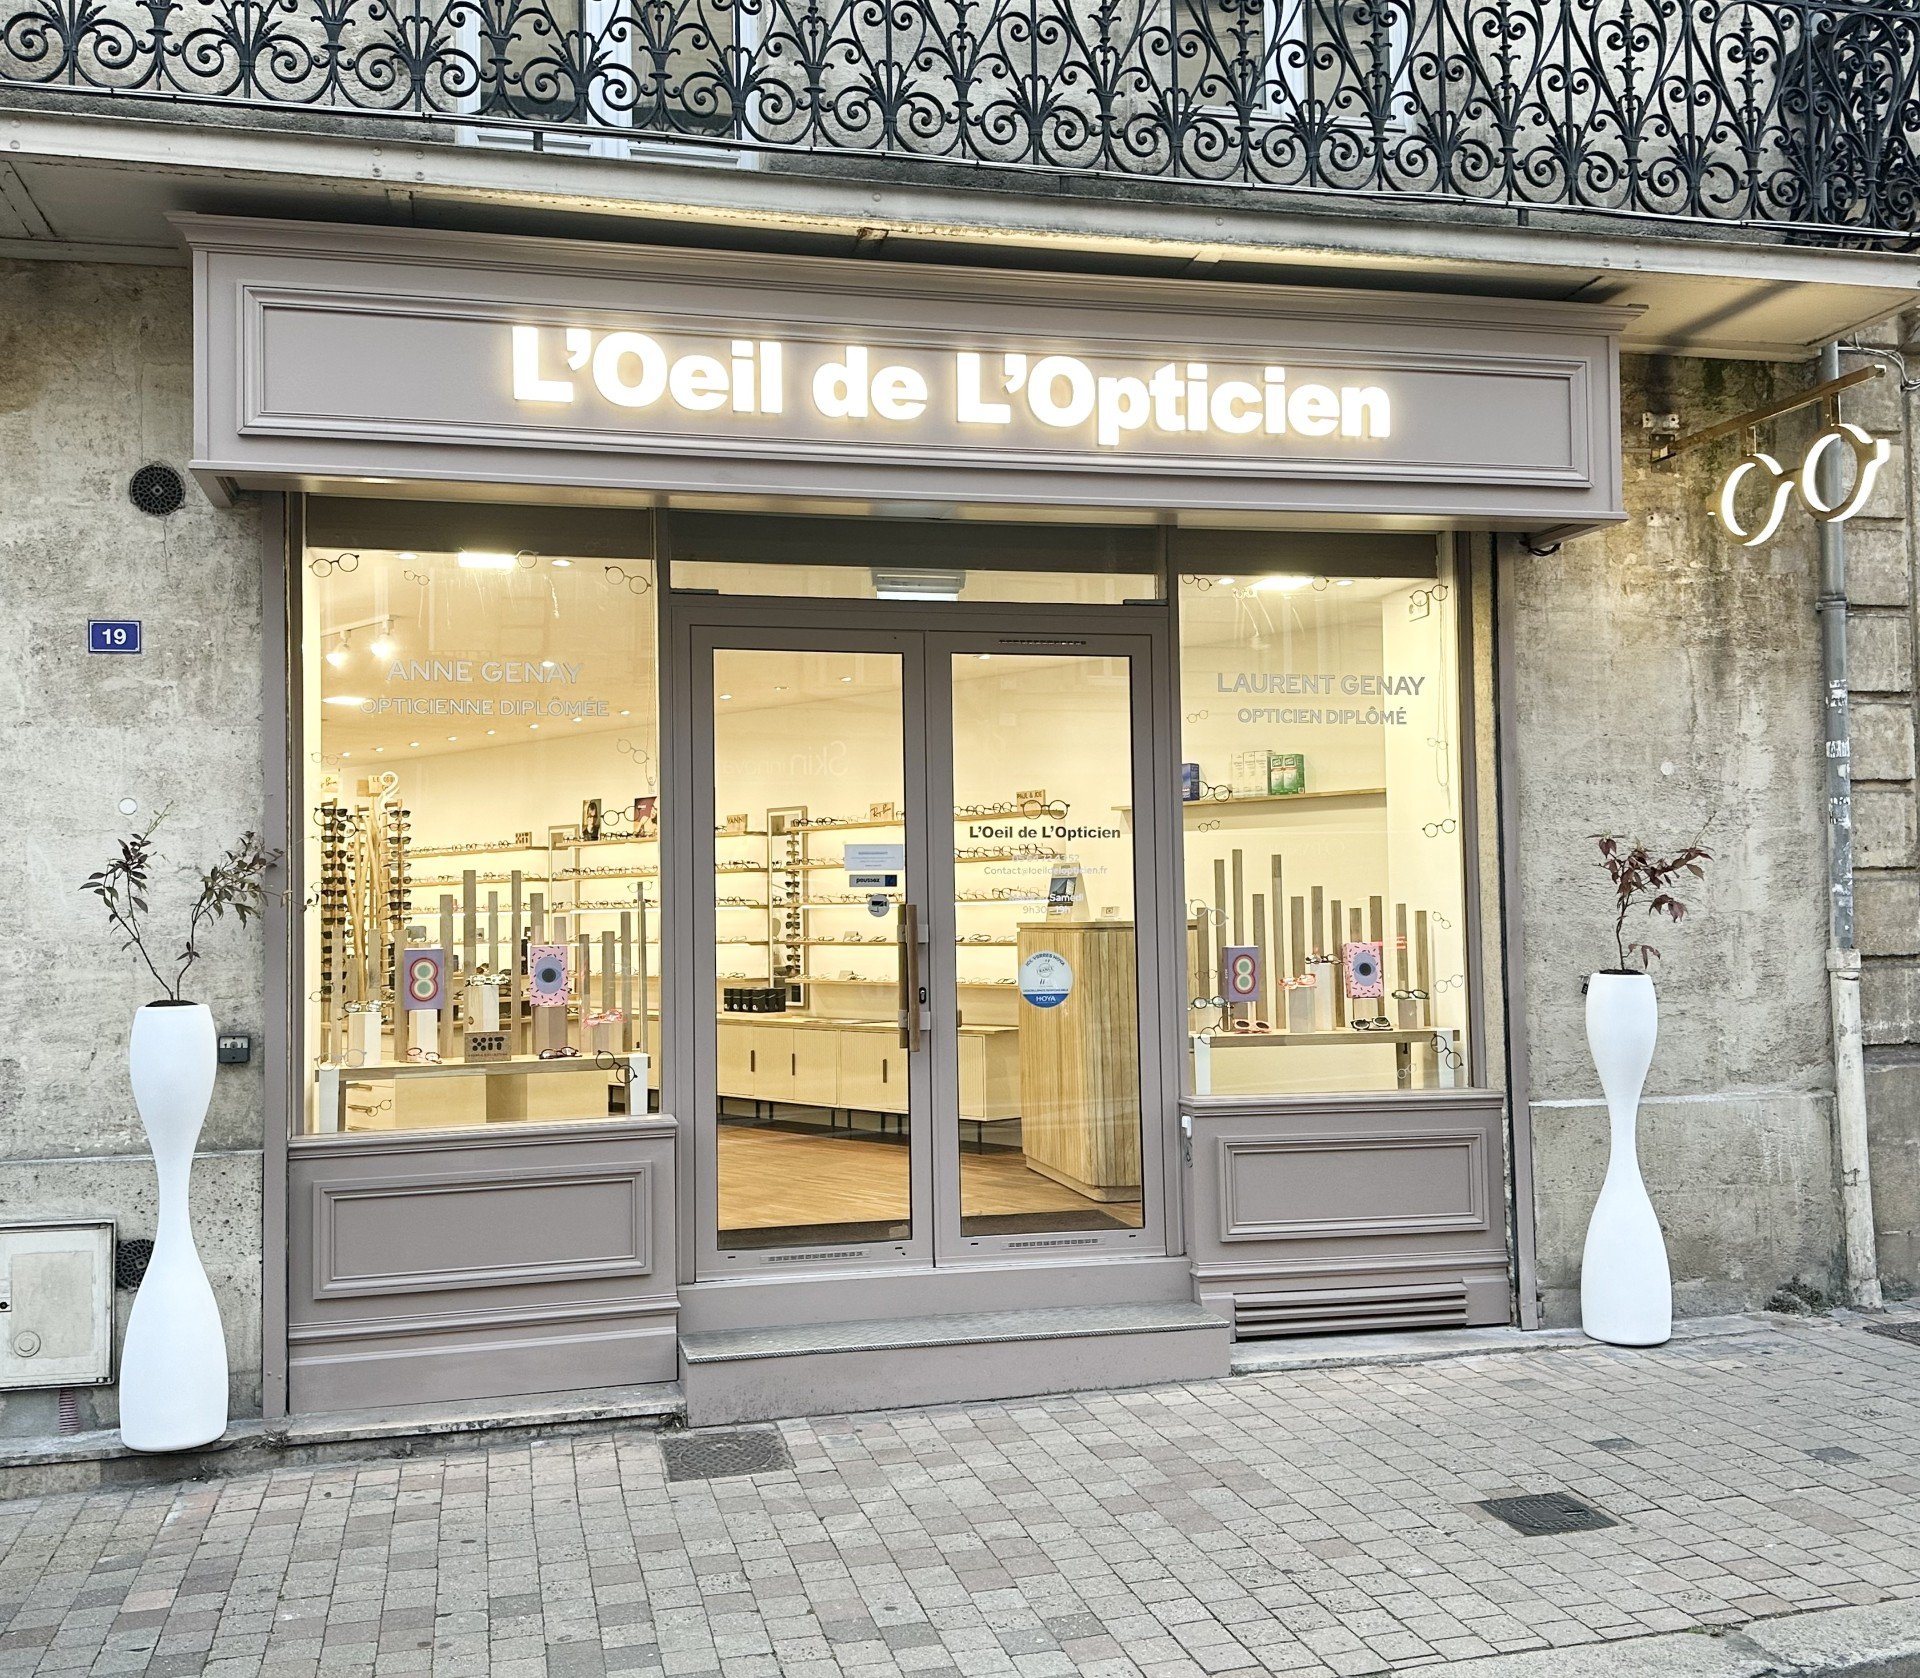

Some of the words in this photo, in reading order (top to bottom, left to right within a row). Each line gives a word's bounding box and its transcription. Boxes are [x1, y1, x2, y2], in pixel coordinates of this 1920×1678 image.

[512, 325, 782, 413] L'Oeil
[812, 346, 928, 420] de
[956, 352, 1390, 446] L'Opticien
[102, 628, 127, 645] 19
[386, 659, 474, 682] ANNE
[480, 661, 583, 684] GENAY
[1217, 672, 1335, 695] LAURENT
[1340, 674, 1425, 696] GENAY
[359, 697, 495, 715] OPTICIENNE
[499, 696, 610, 717] DIPLÔMÉE
[1237, 708, 1322, 724] OPTICIEN
[1326, 705, 1407, 725] DIPLÔMÉ
[969, 826, 1013, 839] L'Oeil
[1018, 826, 1037, 839] de
[1042, 826, 1121, 841] L'Opticien
[1049, 893, 1084, 902] Samedi
[1022, 905, 1047, 914] 9h30
